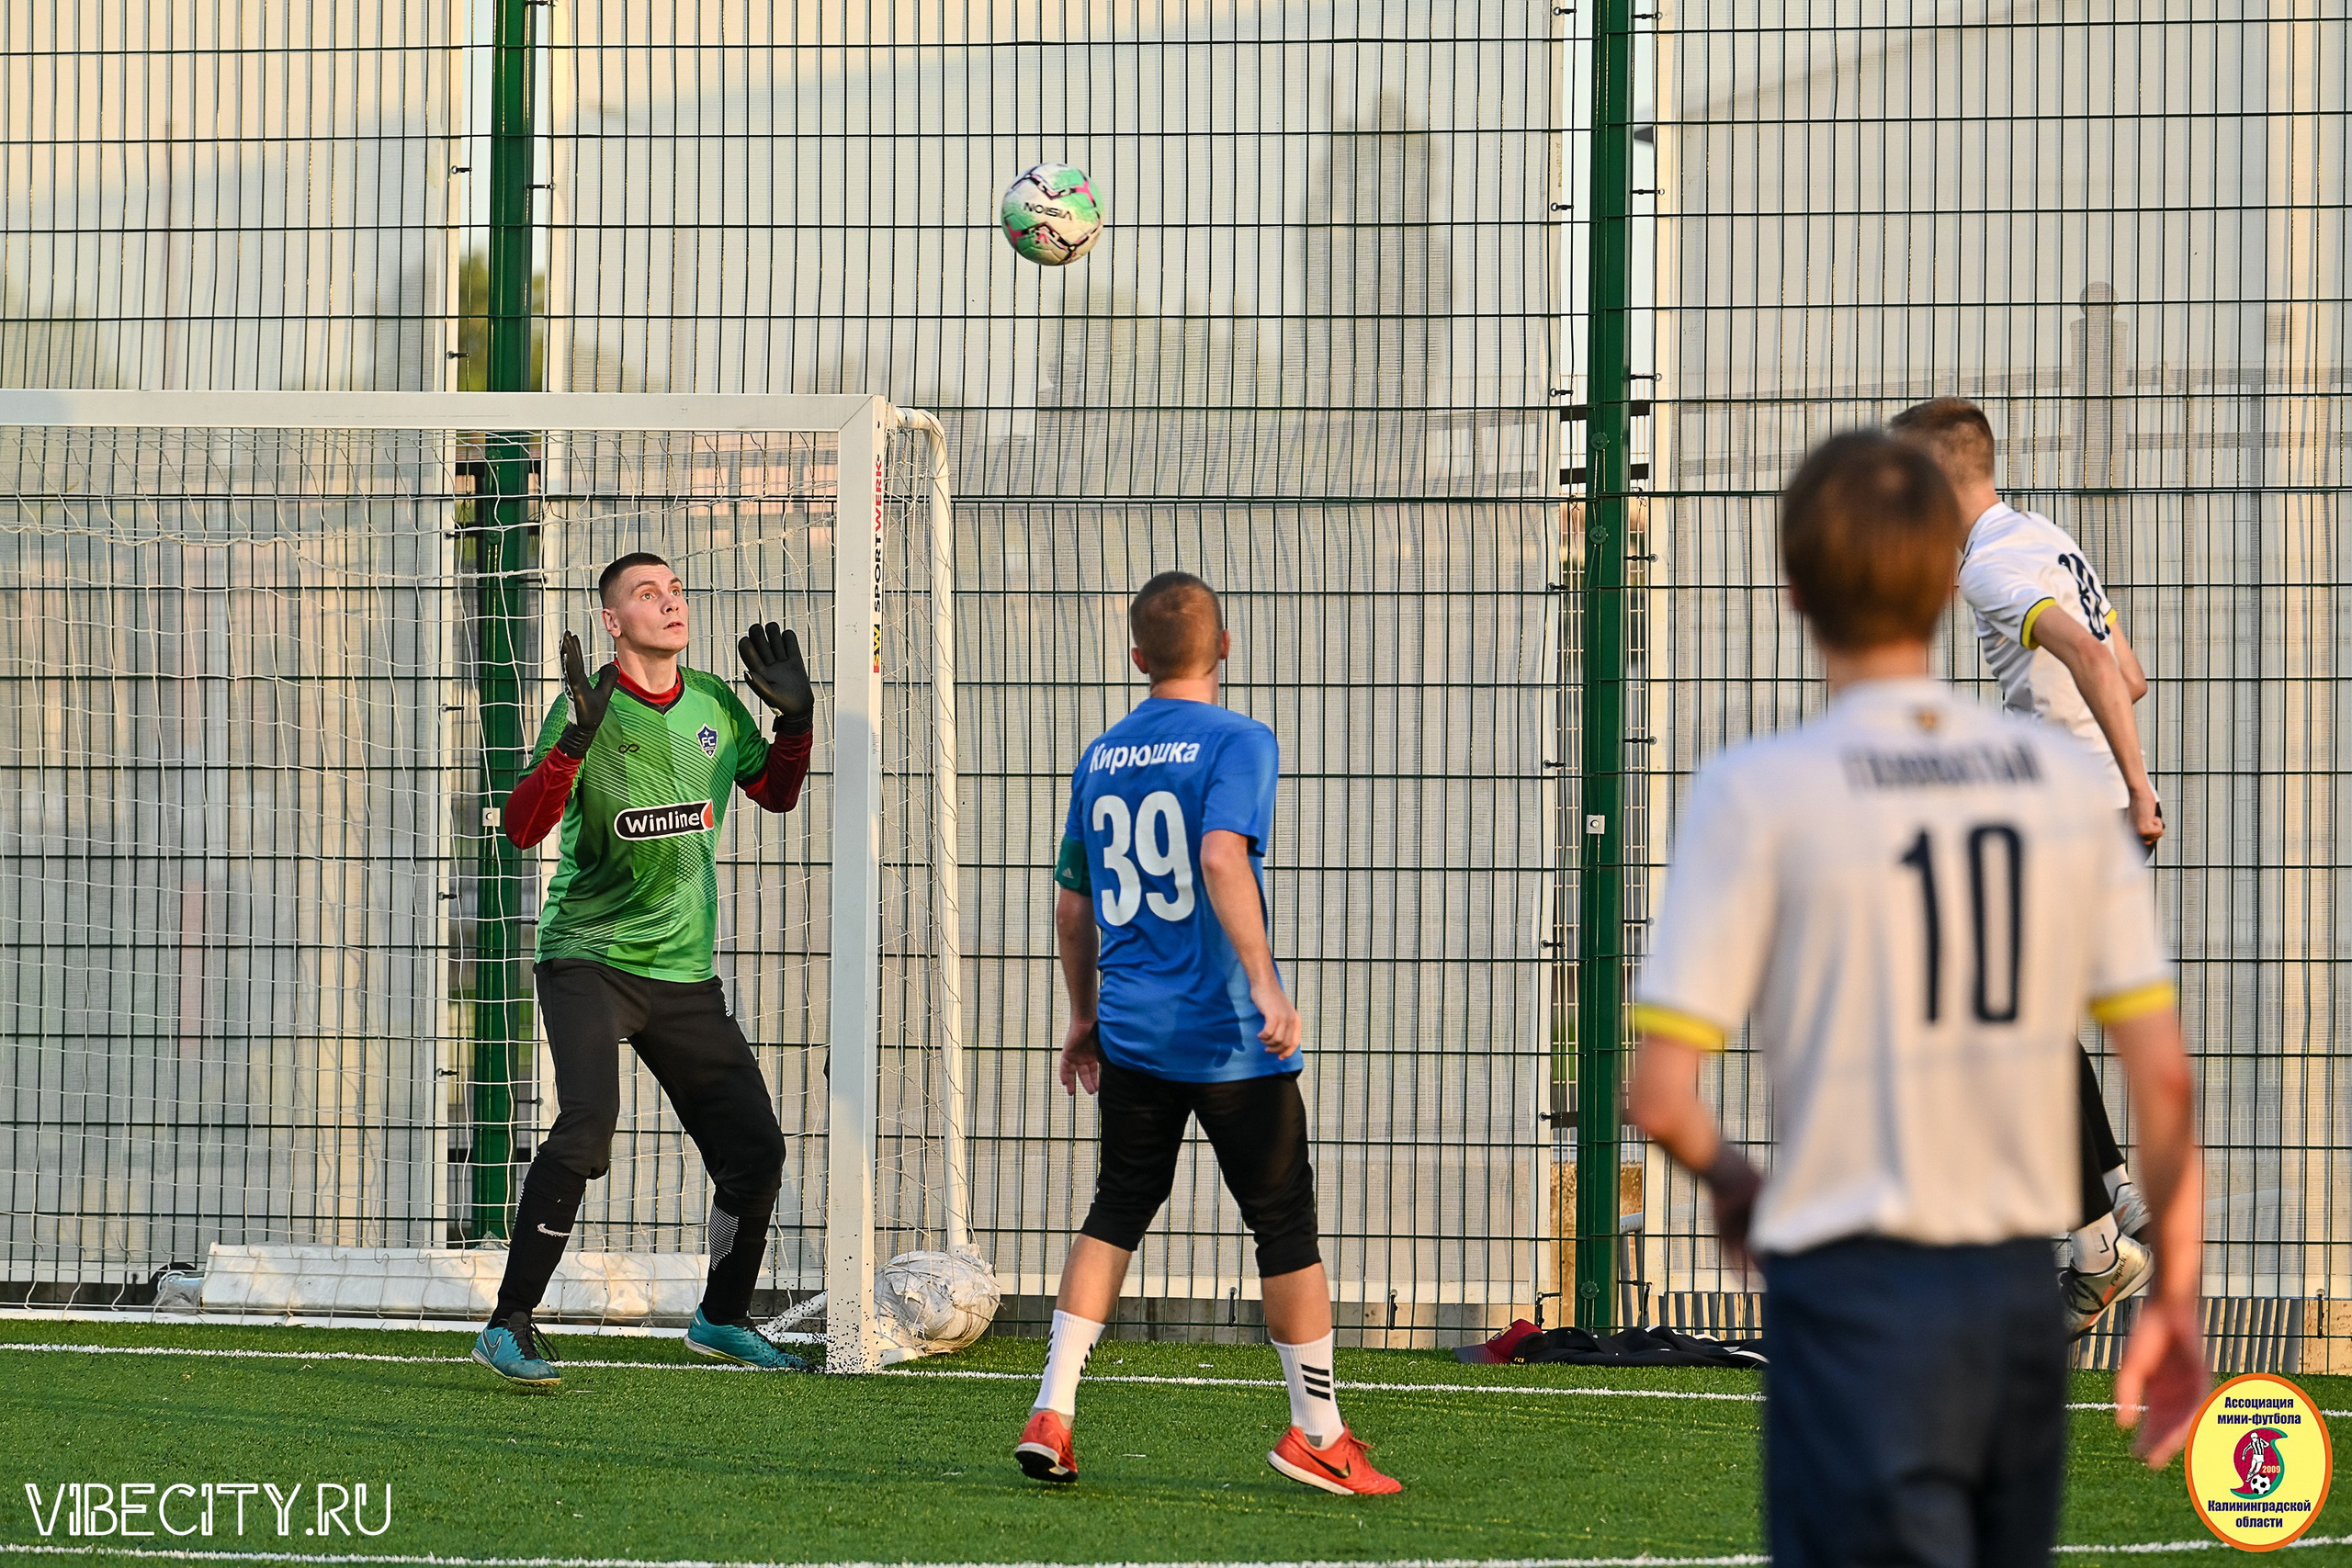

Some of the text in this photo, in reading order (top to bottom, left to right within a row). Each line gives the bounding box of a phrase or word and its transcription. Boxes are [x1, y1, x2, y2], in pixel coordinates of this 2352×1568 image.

[1023, 202, 1073, 220] VISION
[874, 460, 882, 613] SPORTWERK
[701, 736, 716, 747] FC
[1089, 742, 1200, 775] Кирюшка
[625, 811, 700, 834] Winline
[1092, 791, 1195, 926] 39
[1898, 824, 2021, 1023] 10
